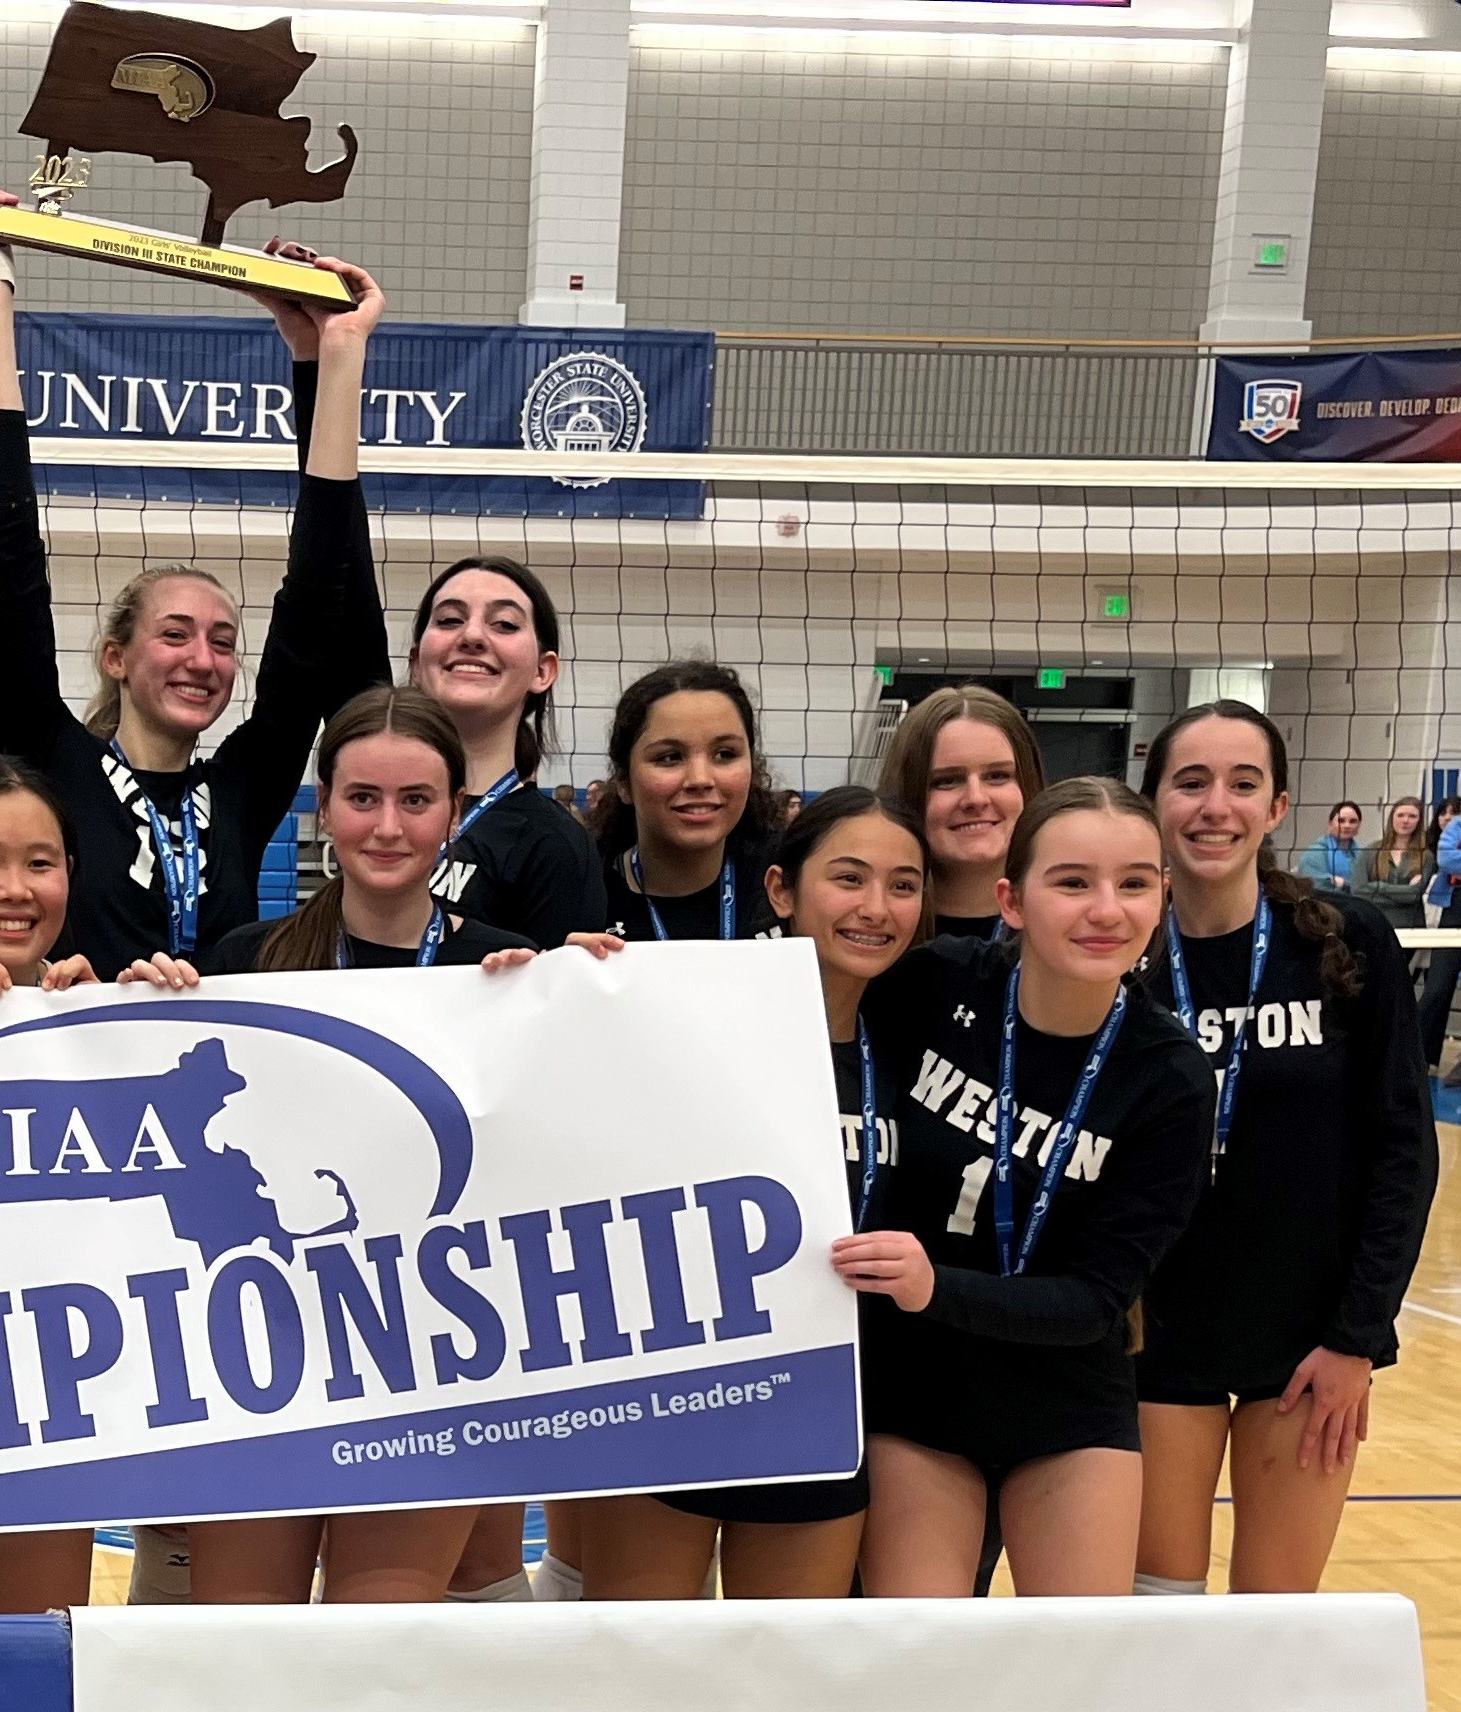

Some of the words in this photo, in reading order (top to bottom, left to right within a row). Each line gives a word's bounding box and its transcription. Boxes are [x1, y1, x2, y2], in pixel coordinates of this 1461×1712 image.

[29, 154, 91, 185] 2023
[92, 238, 139, 257] DIVISION
[142, 248, 153, 260] III
[156, 251, 187, 266] STATE
[190, 258, 247, 277] CHAMPION
[129, 234, 149, 245] 2023
[173, 243, 212, 257] Volleyball
[566, 363, 609, 378] STATE
[15, 369, 466, 446] UNIVERTY
[1255, 395, 1289, 418] 50
[1317, 401, 1375, 418] DISCOVER.
[1379, 399, 1431, 417] DEVELOP.
[1435, 397, 1461, 415] DED
[1096, 1011, 1119, 1051] CHAMPION
[1196, 1000, 1323, 1054] STON
[1069, 1079, 1090, 1119] CHAMPION
[1000, 1115, 1009, 1157] CHAMPION
[1044, 1148, 1063, 1188] CHAMPION
[946, 1155, 994, 1236] 1
[331, 1426, 454, 1467] Growing
[462, 1400, 643, 1448] Courageous
